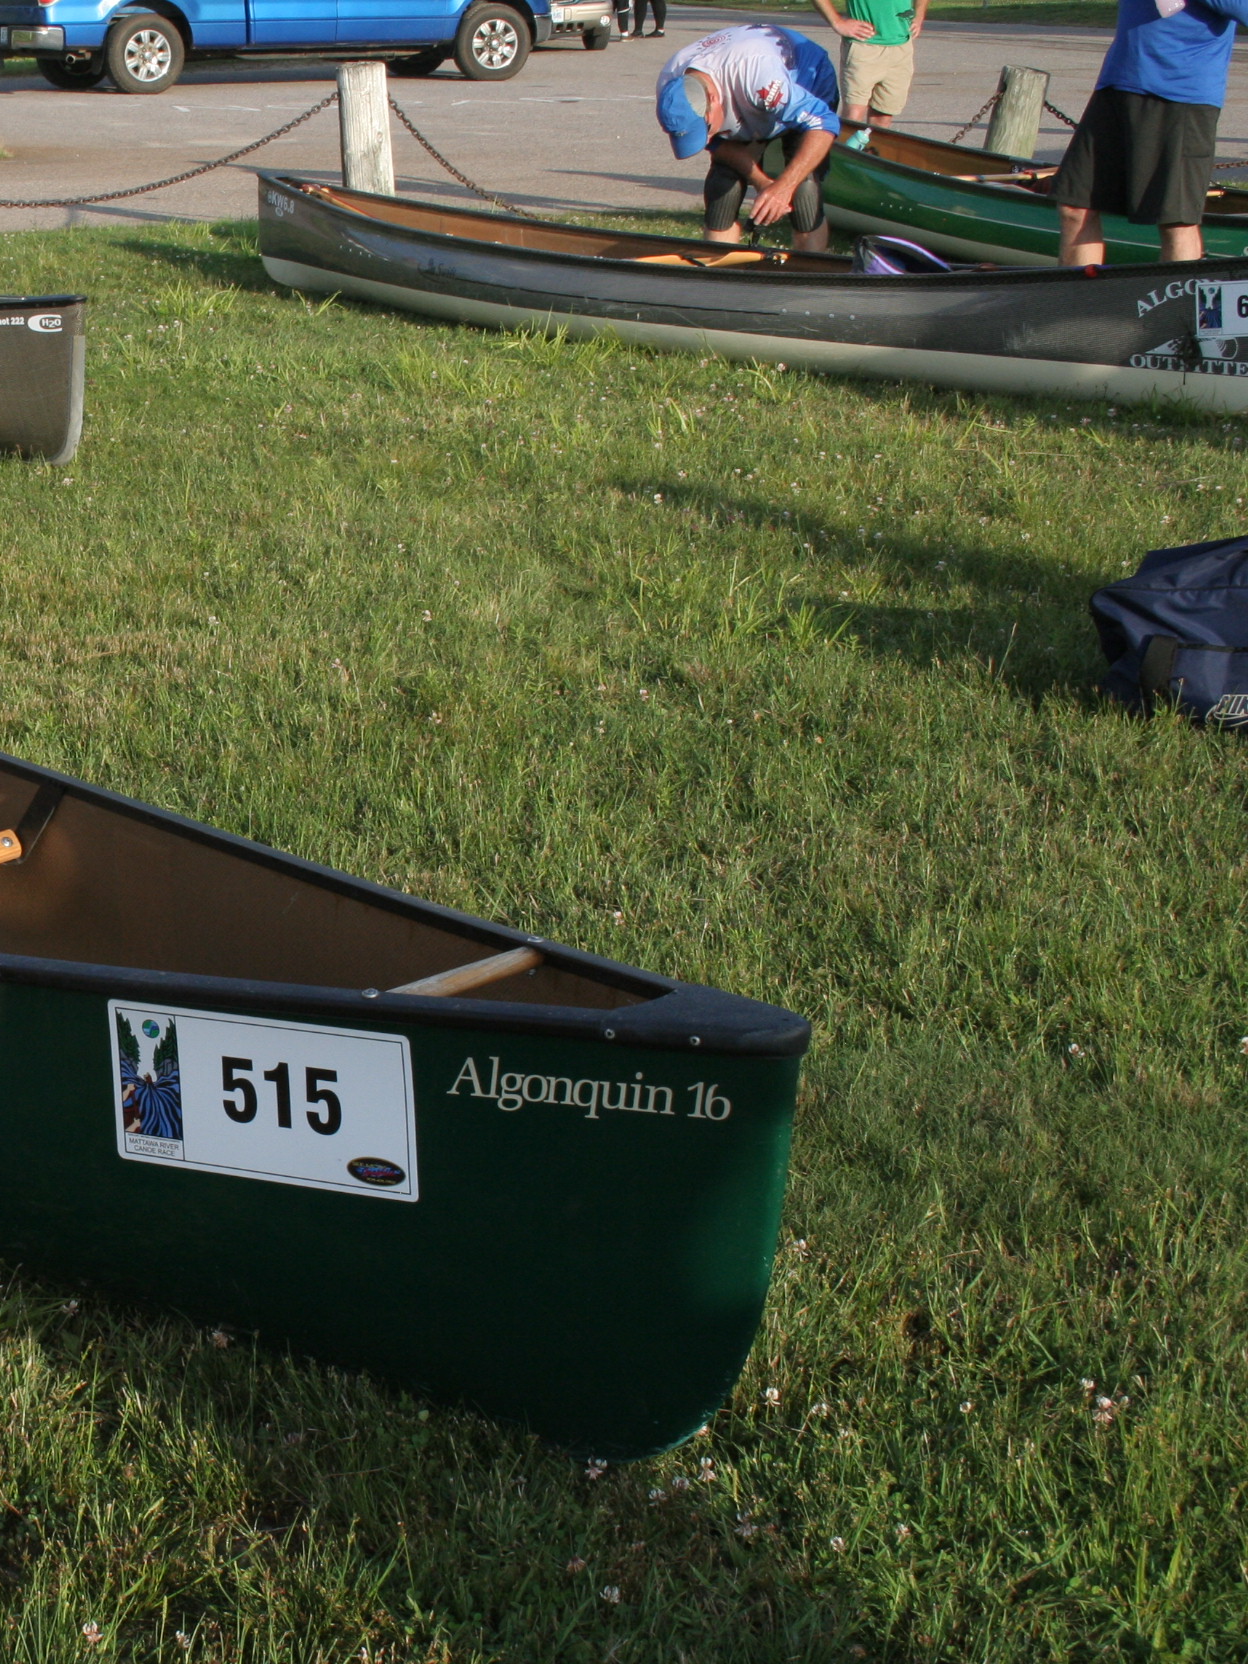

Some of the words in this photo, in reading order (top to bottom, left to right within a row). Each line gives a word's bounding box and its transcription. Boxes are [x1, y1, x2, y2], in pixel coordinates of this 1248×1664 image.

[1136, 279, 1208, 318] ALGO
[10, 316, 25, 326] 222
[222, 1055, 342, 1136] 515
[446, 1056, 675, 1119] Algonquin
[686, 1081, 732, 1121] 16
[129, 1138, 159, 1147] MATTAWA
[159, 1142, 180, 1151] RIVER
[133, 1145, 157, 1154] CANOE
[157, 1148, 176, 1157] RACE
